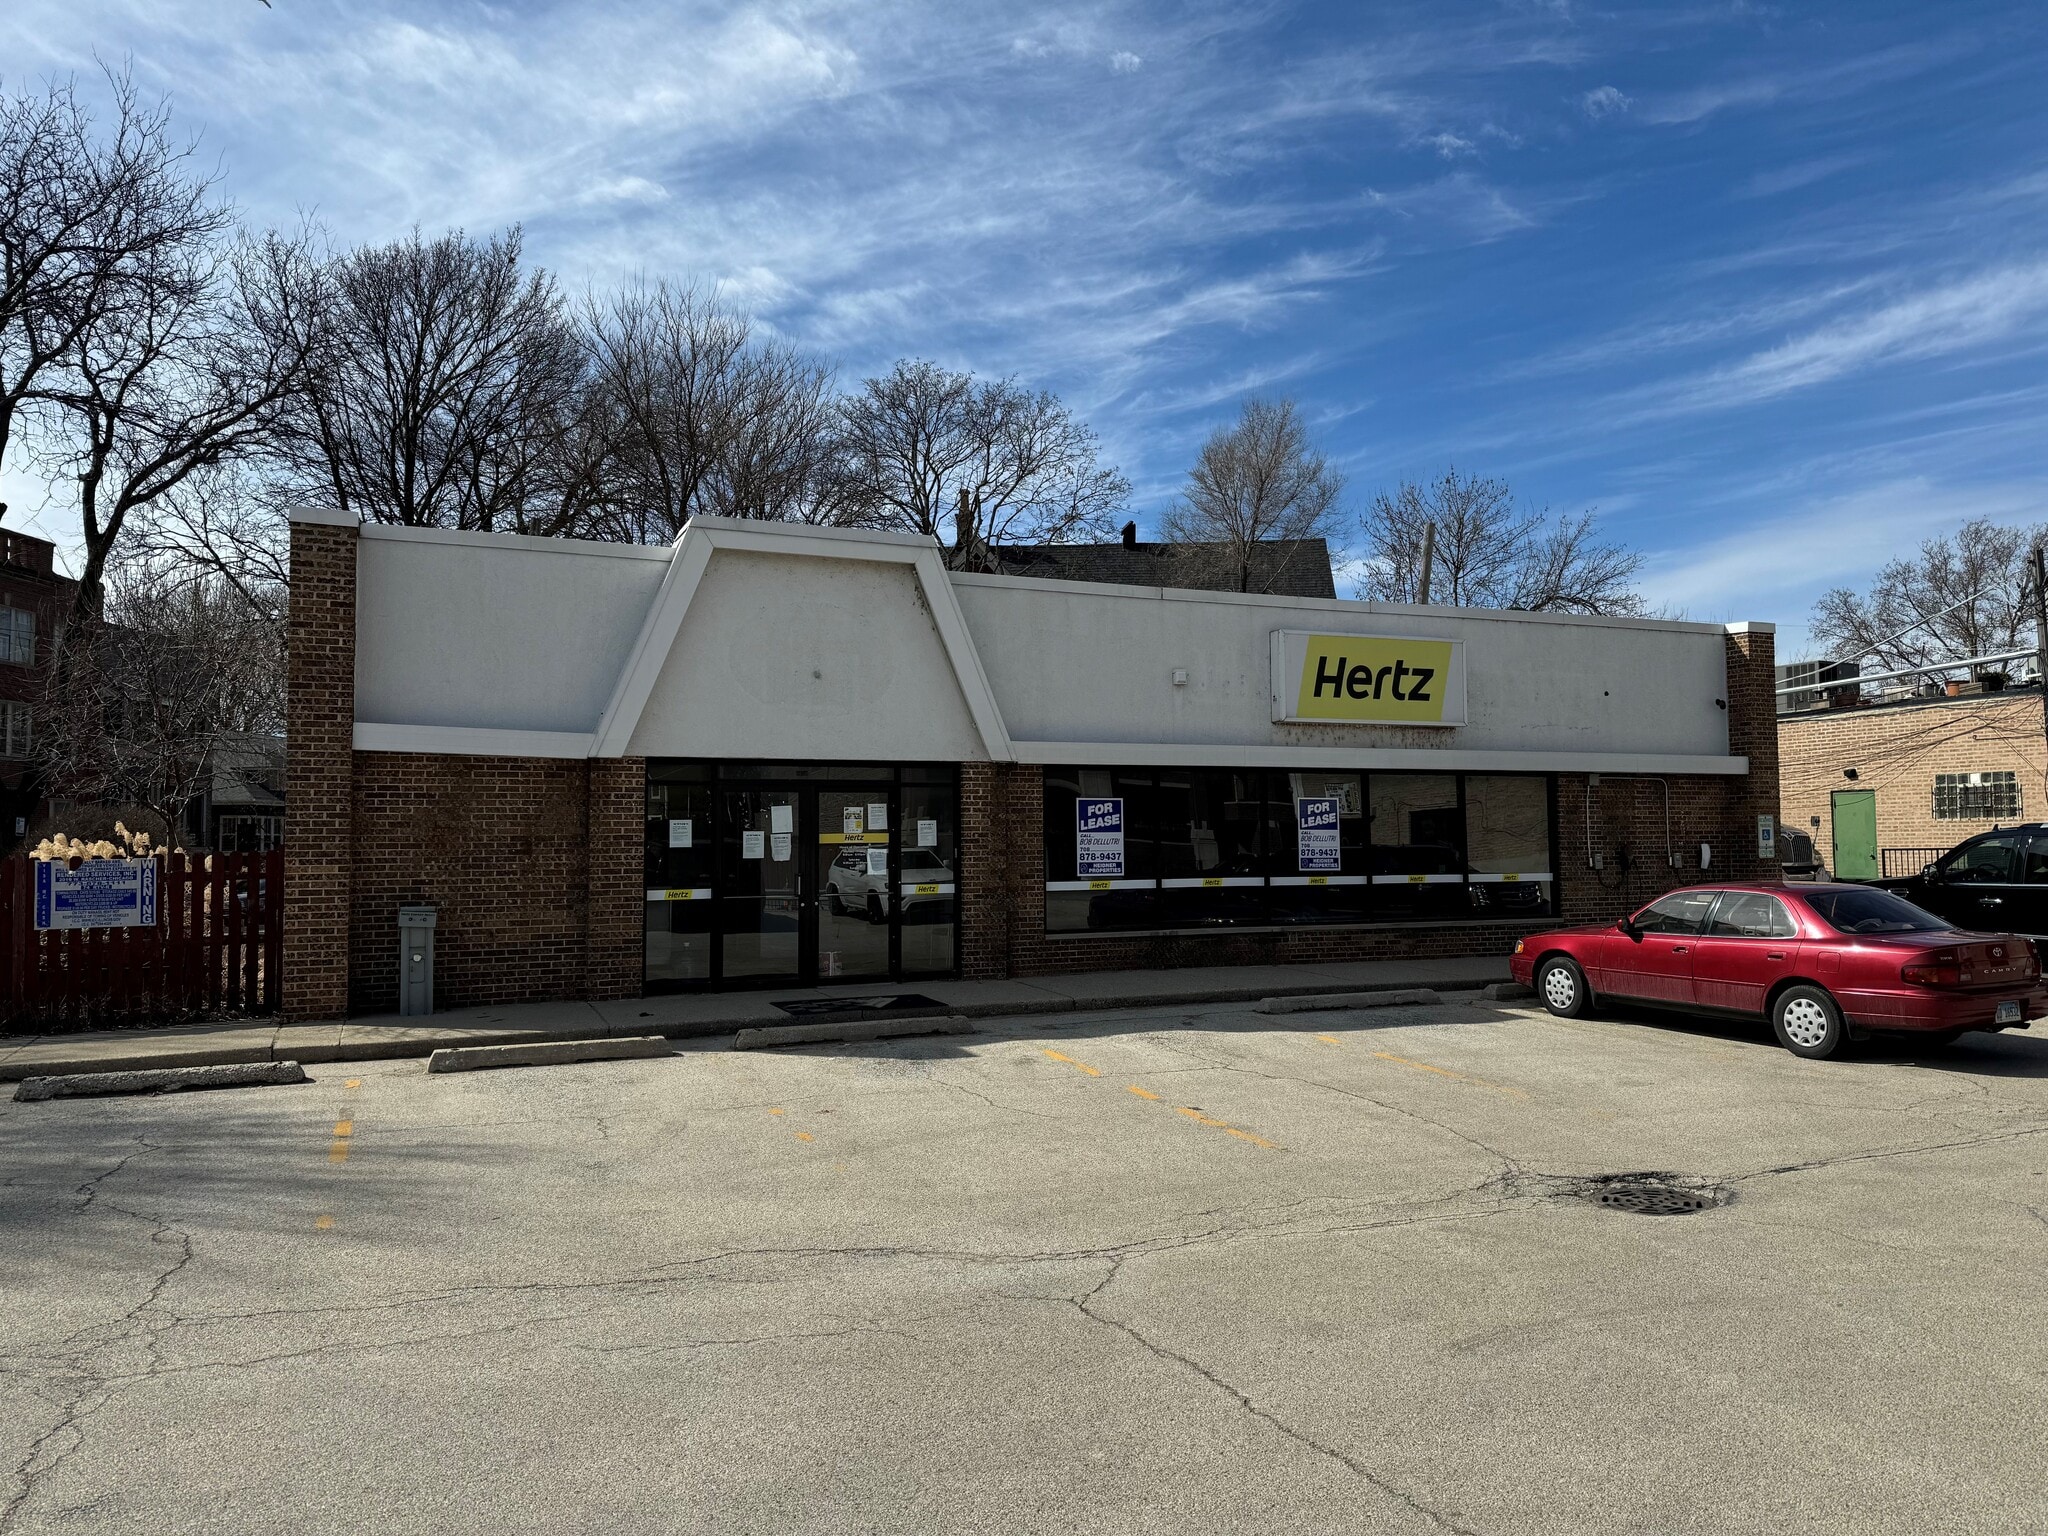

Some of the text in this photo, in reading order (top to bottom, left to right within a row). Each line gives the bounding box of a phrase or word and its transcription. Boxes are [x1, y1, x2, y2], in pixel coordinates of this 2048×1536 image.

[1314, 656, 1434, 702] Hertz
[1088, 802, 1113, 816] FOR
[1307, 802, 1330, 815] FOR
[1080, 813, 1120, 831] LEASE
[1301, 812, 1336, 828] LEASE
[1080, 852, 1122, 861] 878-9437
[142, 859, 154, 923] WARNING
[668, 890, 689, 898] Hertz
